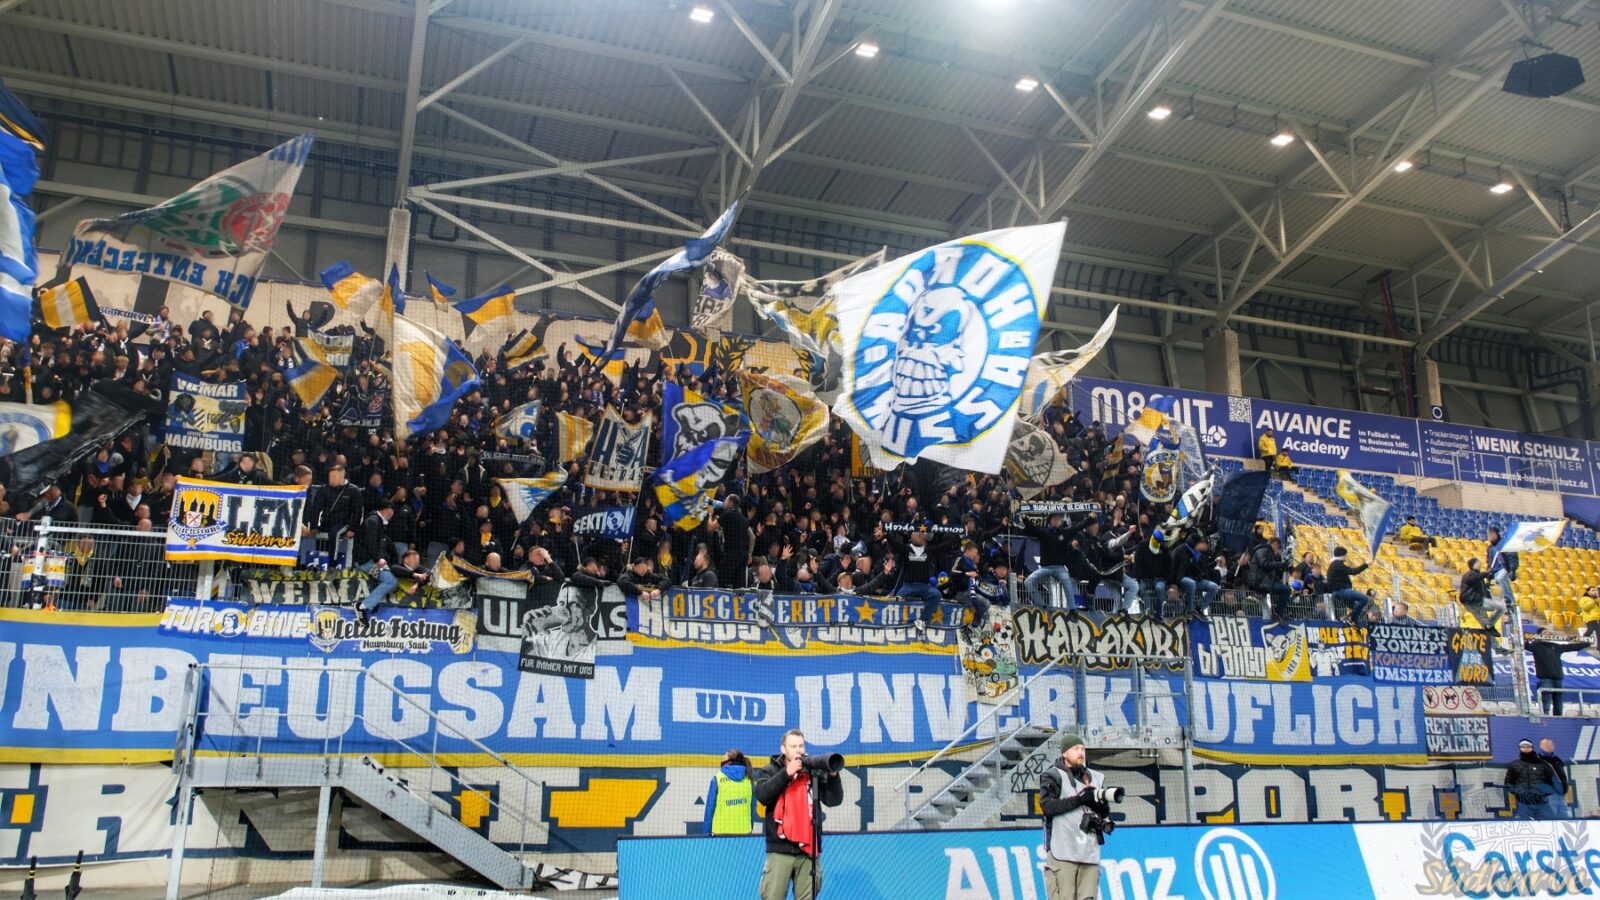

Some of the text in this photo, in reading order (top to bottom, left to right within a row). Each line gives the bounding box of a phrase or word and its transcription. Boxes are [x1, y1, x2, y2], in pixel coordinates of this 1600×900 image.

[176, 377, 239, 398] WEIMAR
[1255, 409, 1351, 440] AVANCE
[164, 432, 242, 453] NAUMBURG
[1282, 437, 1350, 460] Academy
[1368, 439, 1395, 448] Business
[1475, 435, 1520, 455] WENK
[224, 495, 303, 540] LFN
[572, 506, 635, 536] SEKTION
[221, 531, 297, 548] Südkurve
[249, 579, 398, 605] WEIMA
[482, 598, 628, 638] ULS
[672, 591, 850, 624] AUSGESERRTE
[881, 603, 927, 625] MIT
[334, 617, 463, 644] Letzte Festung
[1370, 625, 1449, 642] ZUKUNFTS
[1374, 638, 1448, 655] KONZEPT
[535, 660, 562, 672] IMMER
[563, 663, 578, 674] MIT
[579, 665, 593, 676] UNS
[1375, 651, 1449, 670] KONSEQUENT
[1373, 666, 1455, 683] UMSETZEN
[1460, 664, 1490, 683] NORD
[695, 692, 767, 722] UND
[1424, 716, 1488, 735] REFUGEES
[1426, 734, 1491, 753] WELCOME
[945, 845, 1185, 900] Allnz
